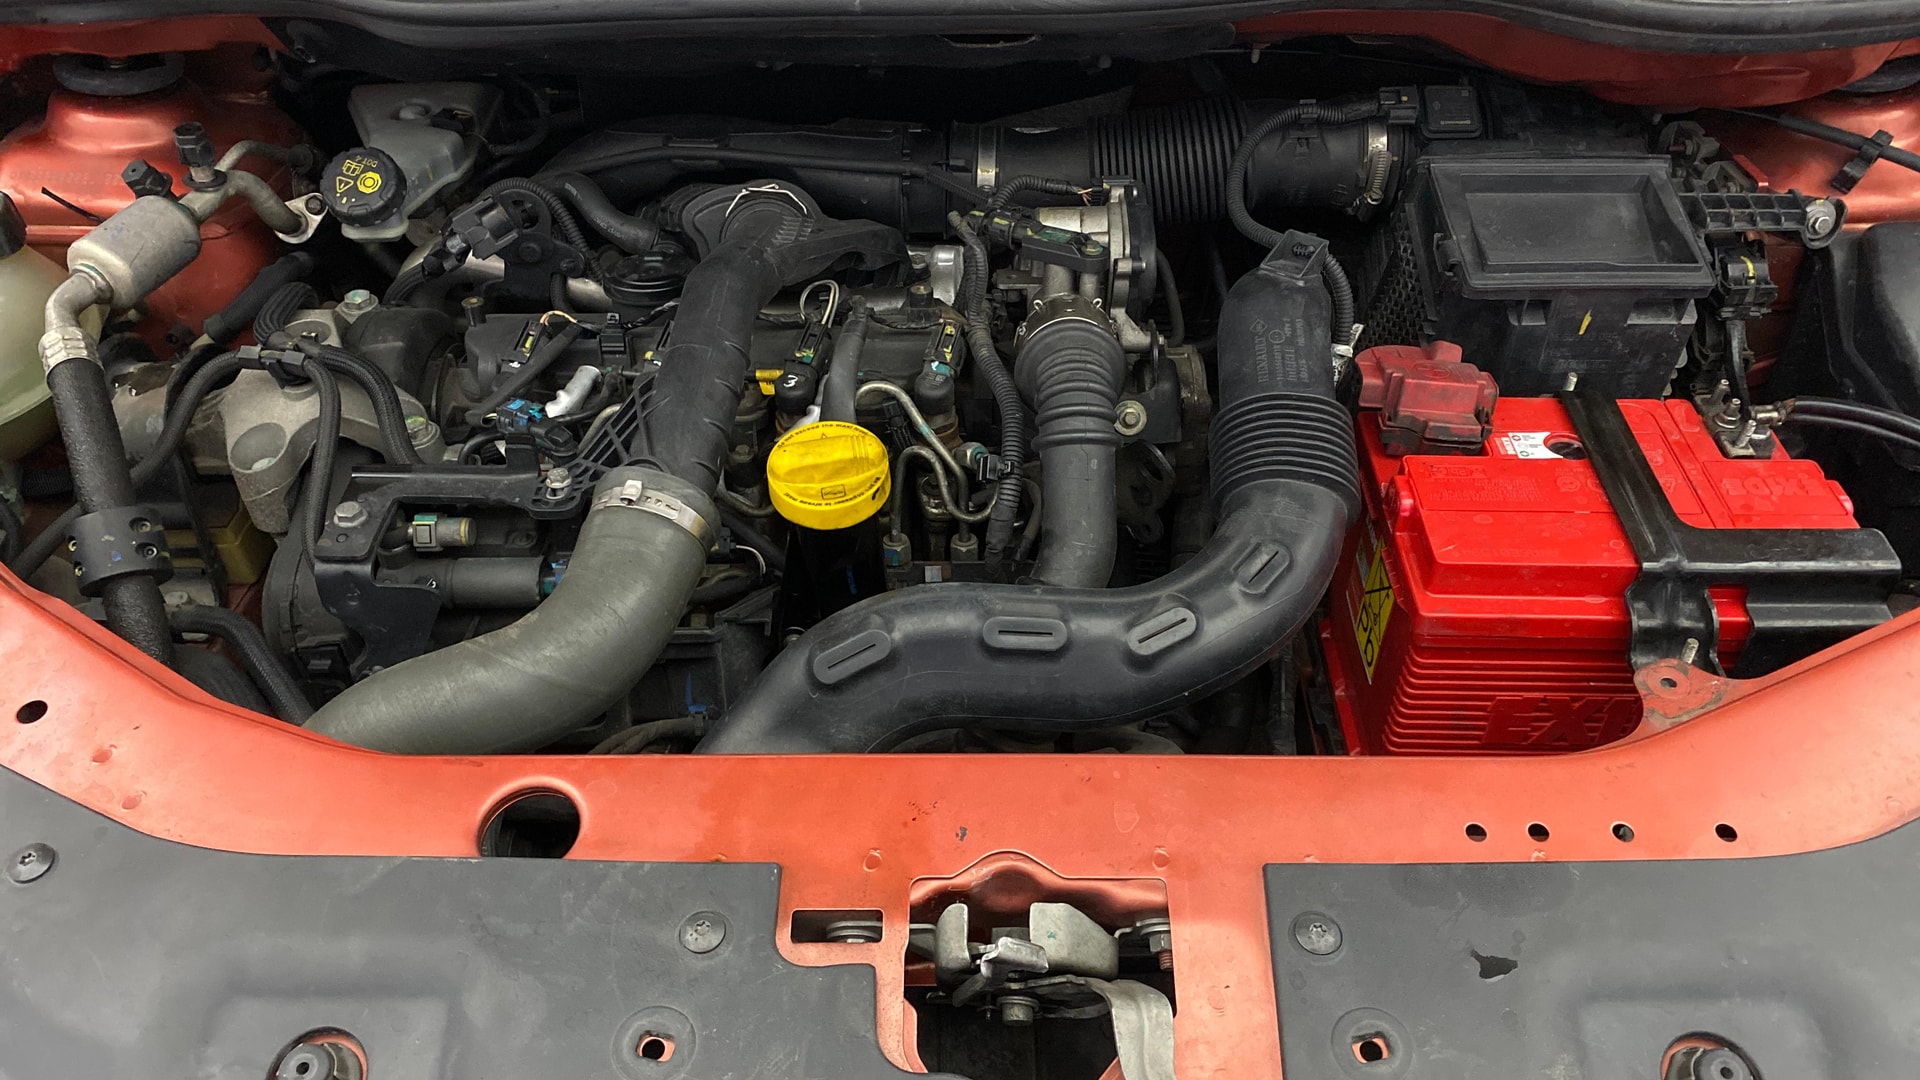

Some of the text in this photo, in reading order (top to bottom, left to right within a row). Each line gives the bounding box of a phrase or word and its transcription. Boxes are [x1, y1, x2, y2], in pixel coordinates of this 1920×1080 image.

[362, 158, 378, 168] DOT
[1254, 335, 1270, 383] RENAULT
[783, 374, 799, 388] 3
[1721, 477, 1828, 497] EXIDE
[1357, 605, 1375, 667] Pb
[1481, 695, 1642, 745] EXI
